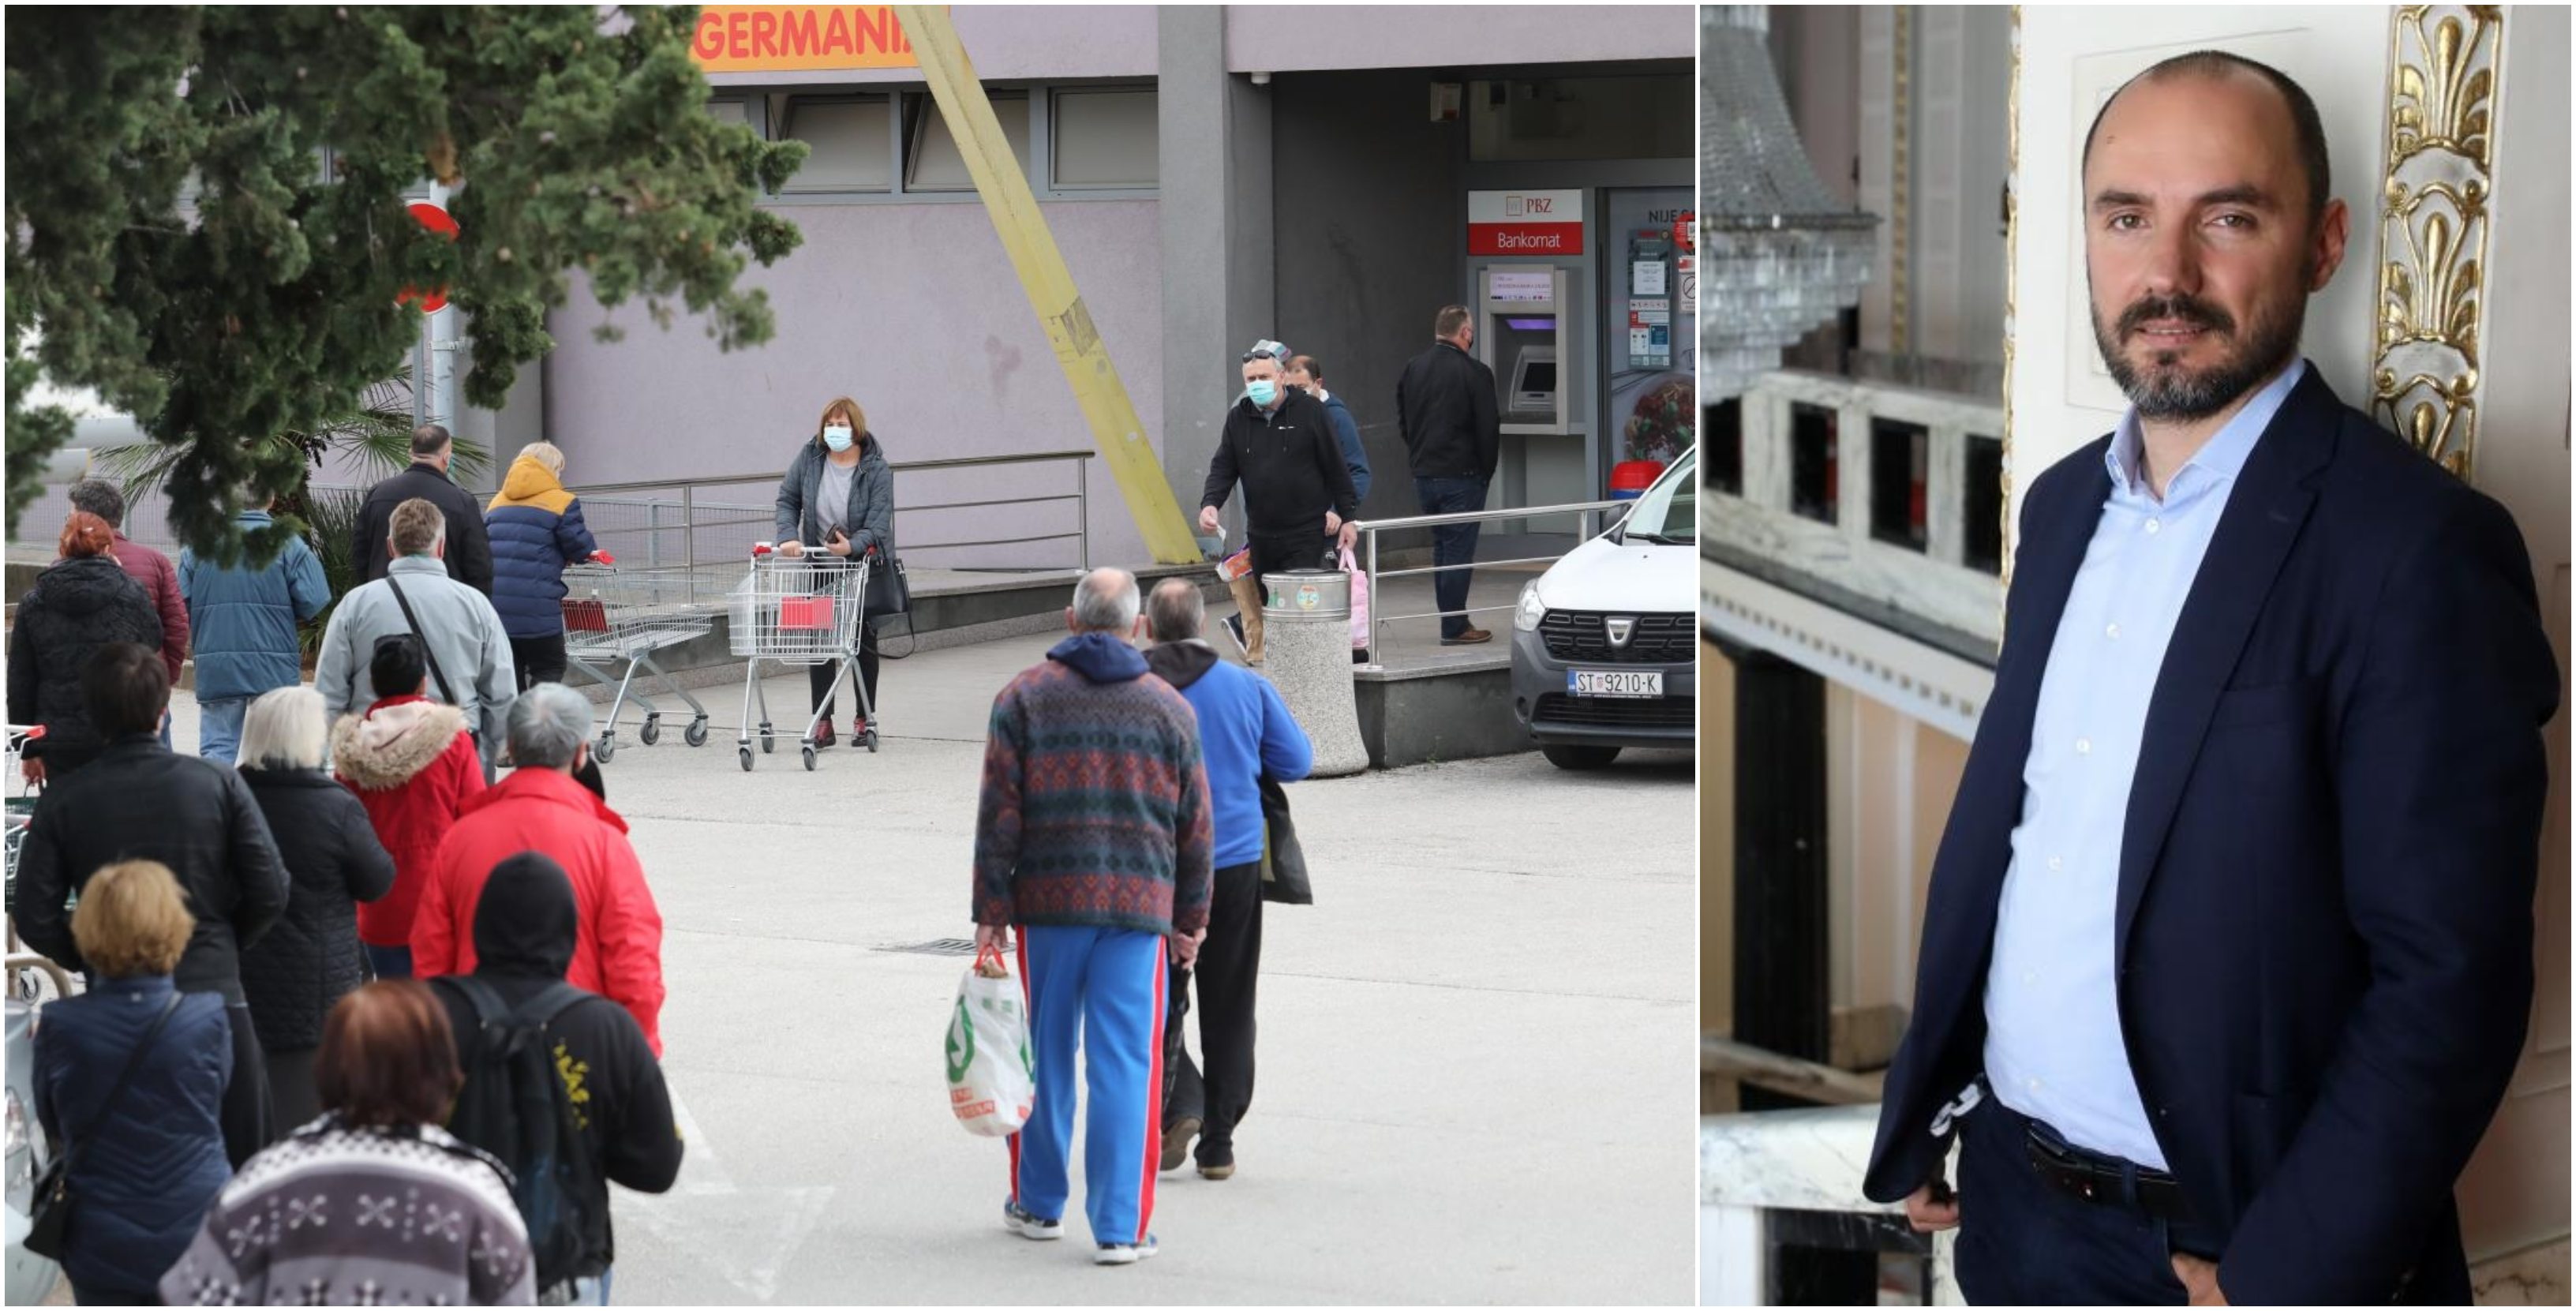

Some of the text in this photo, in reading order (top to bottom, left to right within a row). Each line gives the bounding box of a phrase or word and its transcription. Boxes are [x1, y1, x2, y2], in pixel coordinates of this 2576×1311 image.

[695, 7, 912, 59] GERMANI
[1526, 198, 1553, 213] PBZ
[1649, 209, 1677, 223] NIJE
[1498, 232, 1561, 249] Bankomat
